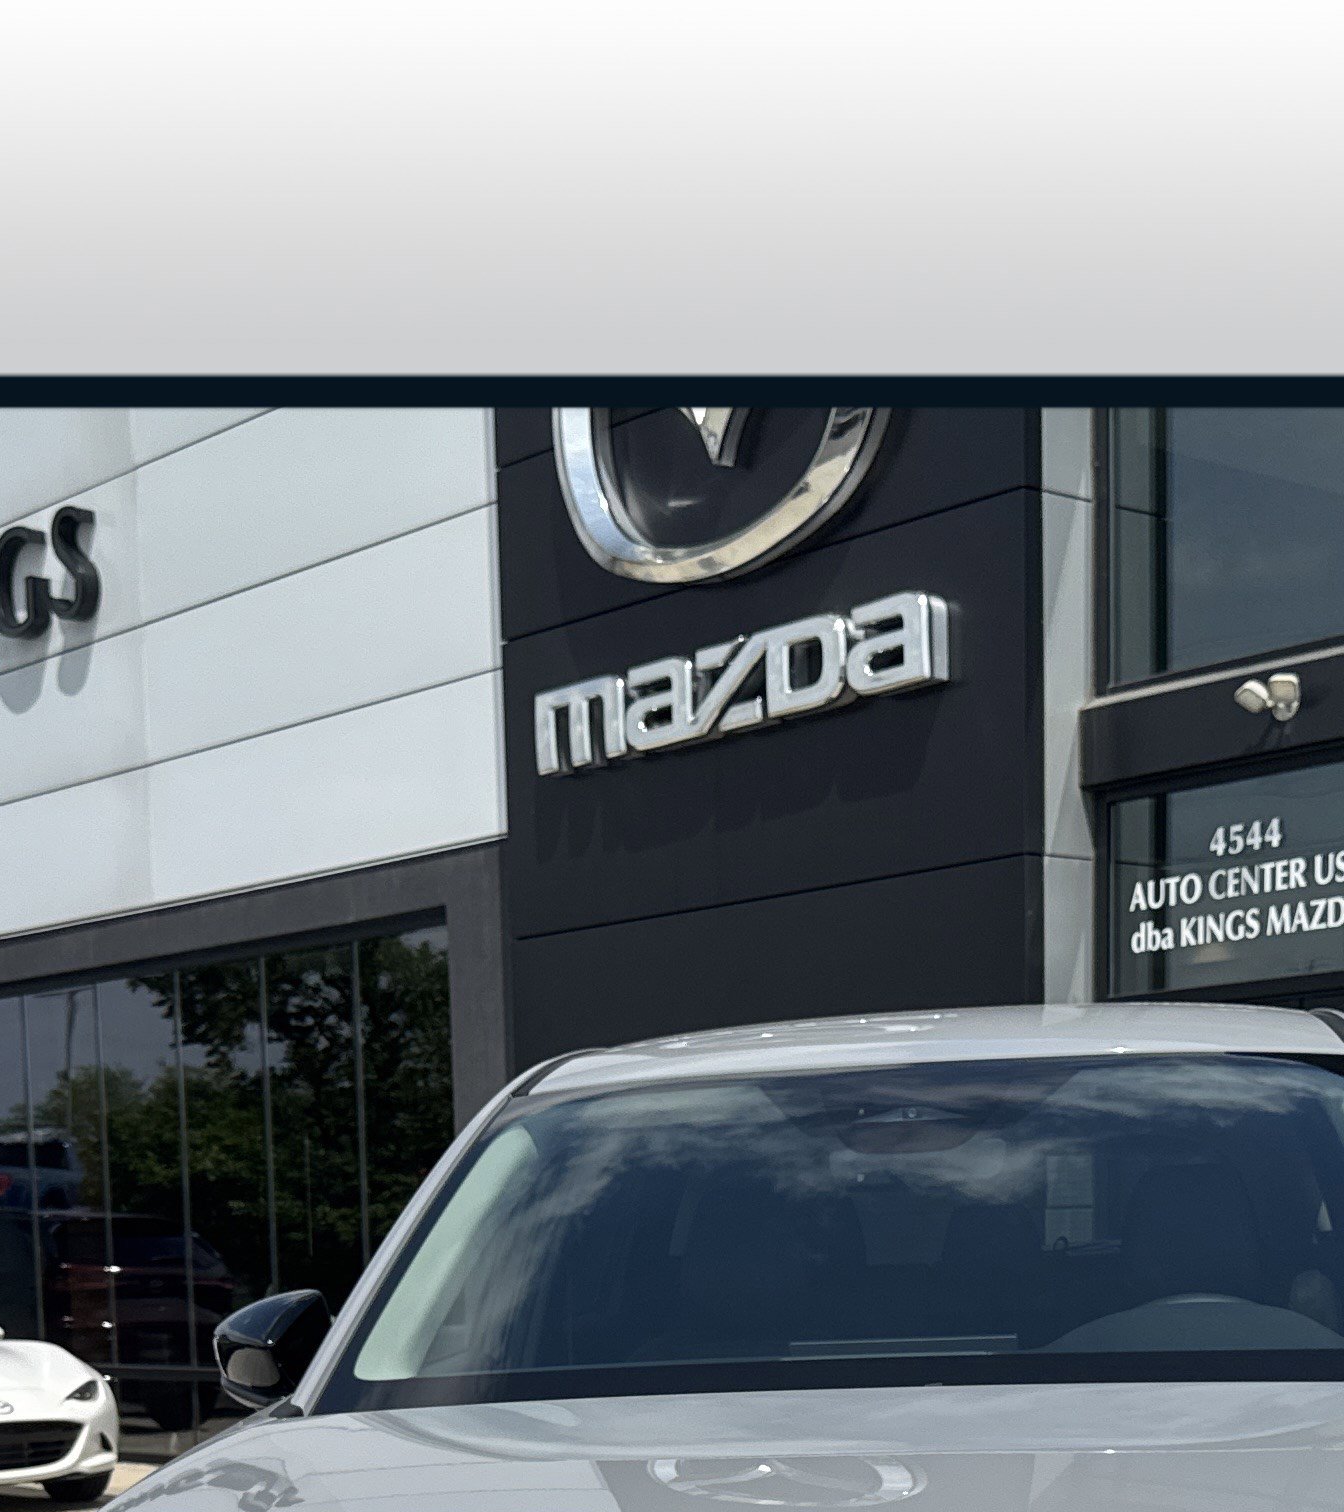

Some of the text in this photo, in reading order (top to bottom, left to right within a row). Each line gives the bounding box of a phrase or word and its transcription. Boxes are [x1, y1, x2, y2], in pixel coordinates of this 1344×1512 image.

[535, 590, 951, 777] mazda
[1209, 817, 1284, 857] 4544
[1128, 872, 1204, 913] AUTO
[1208, 857, 1308, 901] CENTER
[1130, 921, 1175, 954] dba
[1179, 907, 1261, 948] KINGS
